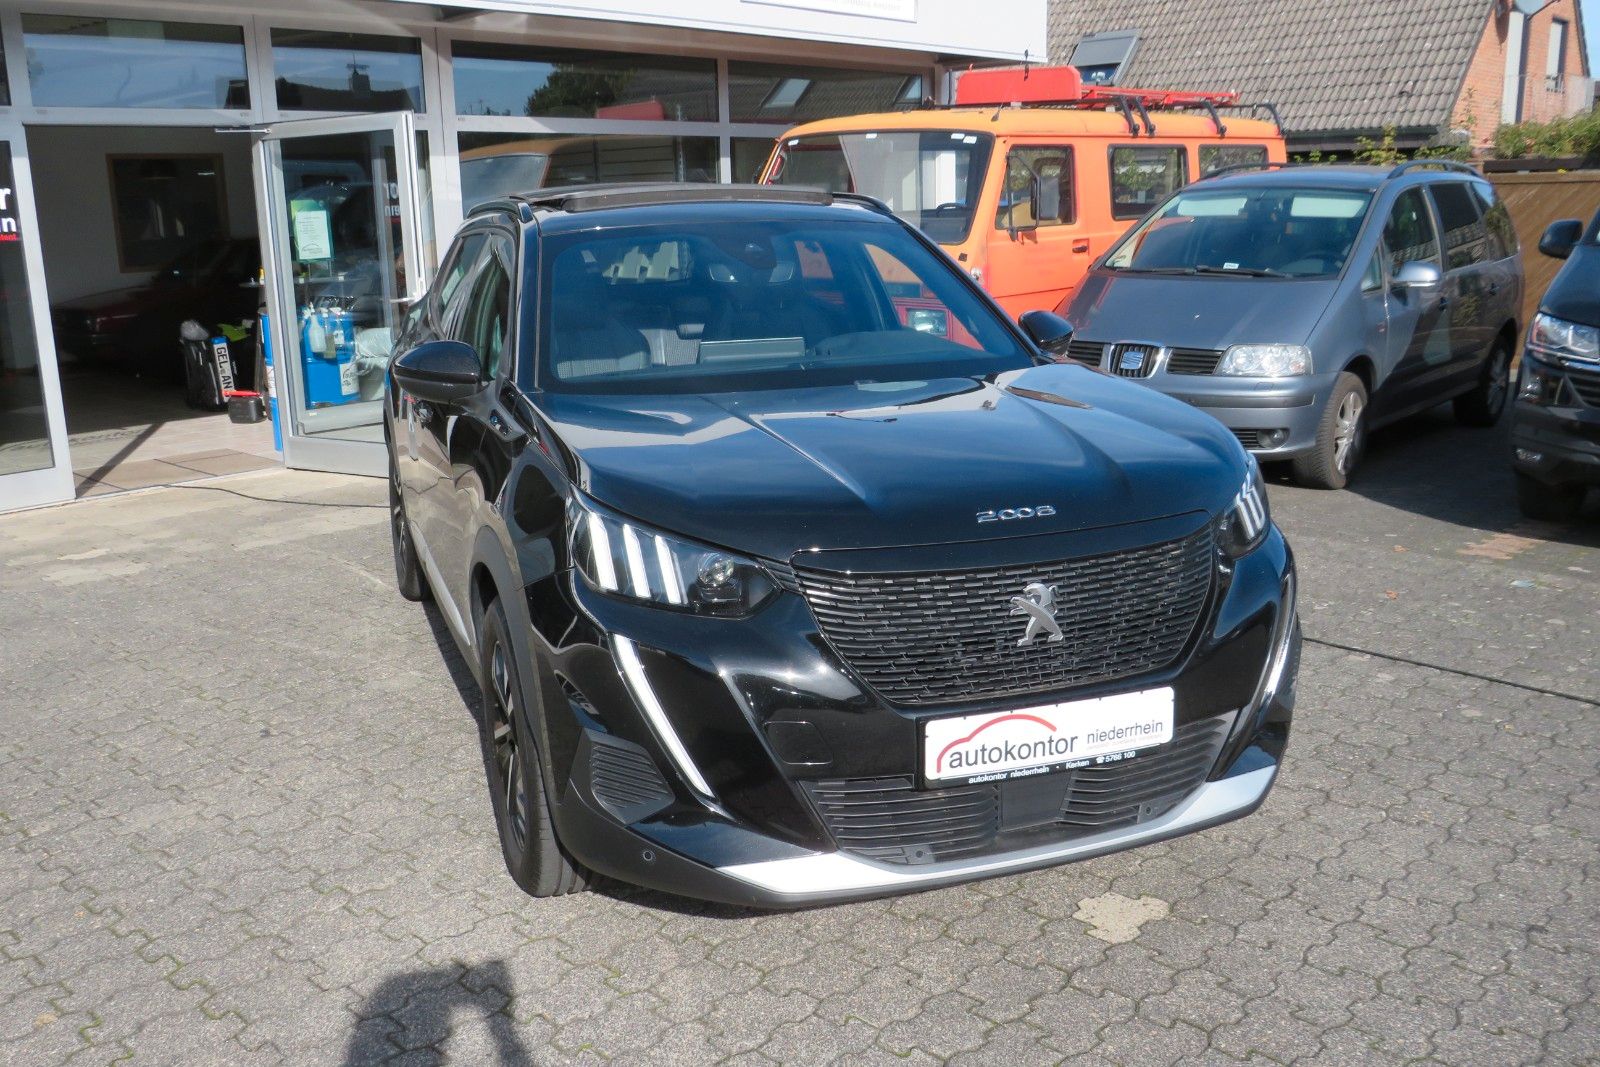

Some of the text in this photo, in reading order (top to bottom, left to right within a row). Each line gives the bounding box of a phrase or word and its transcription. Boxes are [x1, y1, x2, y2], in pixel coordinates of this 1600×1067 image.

[216, 347, 229, 368] GEL
[976, 505, 1056, 523] 2008
[948, 735, 1078, 769] autokontor
[1086, 719, 1163, 744] niederrhein
[968, 773, 1007, 784] autokontor
[1010, 766, 1049, 778] niederrhein
[1123, 750, 1136, 759] 100
